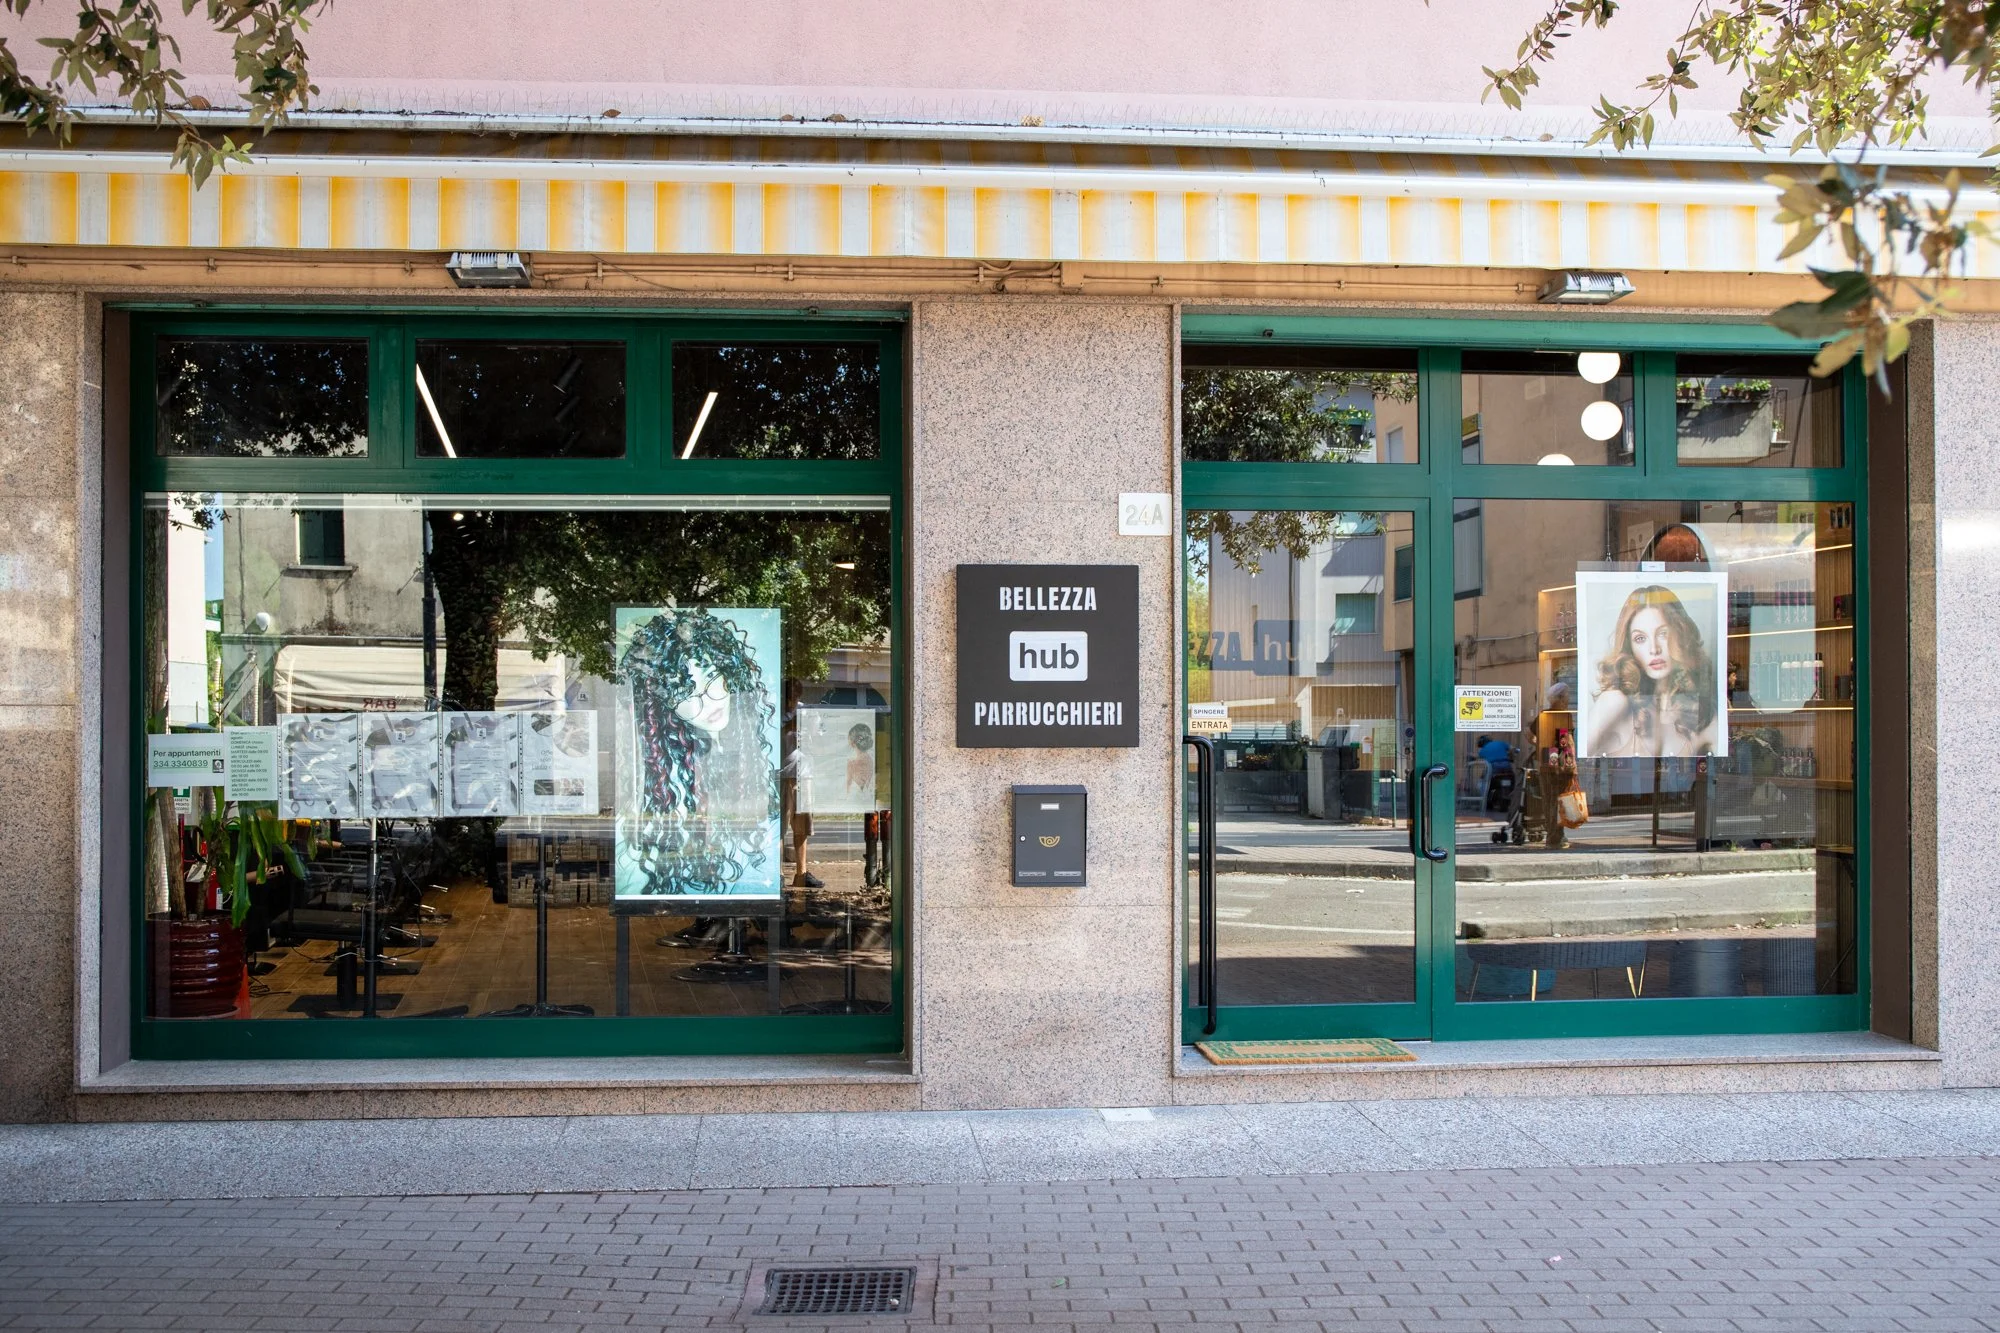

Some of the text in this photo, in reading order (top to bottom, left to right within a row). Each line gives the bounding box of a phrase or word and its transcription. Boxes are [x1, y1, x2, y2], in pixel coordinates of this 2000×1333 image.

[1125, 503, 1164, 526] 24A
[999, 586, 1097, 611] BELLEZZA
[1019, 642, 1080, 669] hub
[974, 701, 1123, 726] PARRUCCHIERI
[1191, 720, 1229, 729] ENTRATA
[153, 748, 221, 758] Per appuntamenti
[153, 759, 208, 768] 334 3340839
